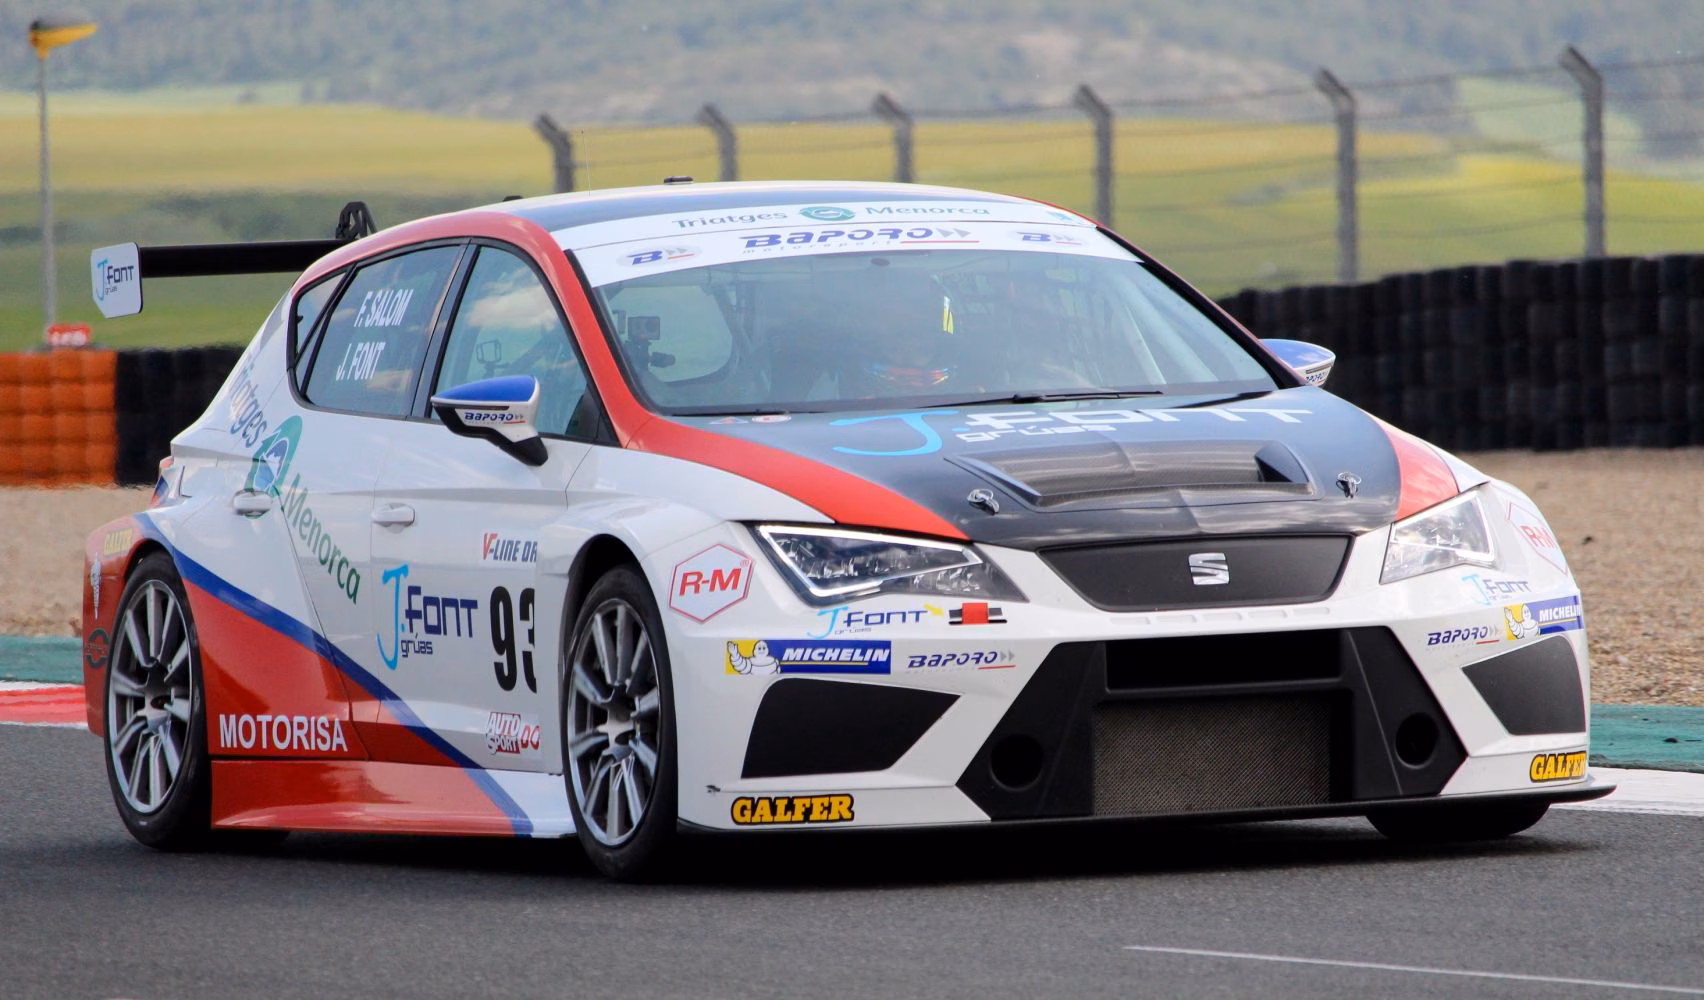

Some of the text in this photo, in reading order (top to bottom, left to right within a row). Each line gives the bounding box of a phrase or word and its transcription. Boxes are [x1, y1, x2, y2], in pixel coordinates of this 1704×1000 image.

[671, 206, 990, 229] Triatges Menorca
[364, 288, 414, 328] SALOM
[347, 341, 386, 381] FONT
[283, 473, 361, 605] Menorca
[482, 532, 521, 562] V-LINE
[678, 567, 742, 597] R-M
[781, 647, 890, 662] MICHELIN
[218, 713, 348, 753] MOTORISA
[731, 794, 854, 826] GALFER
